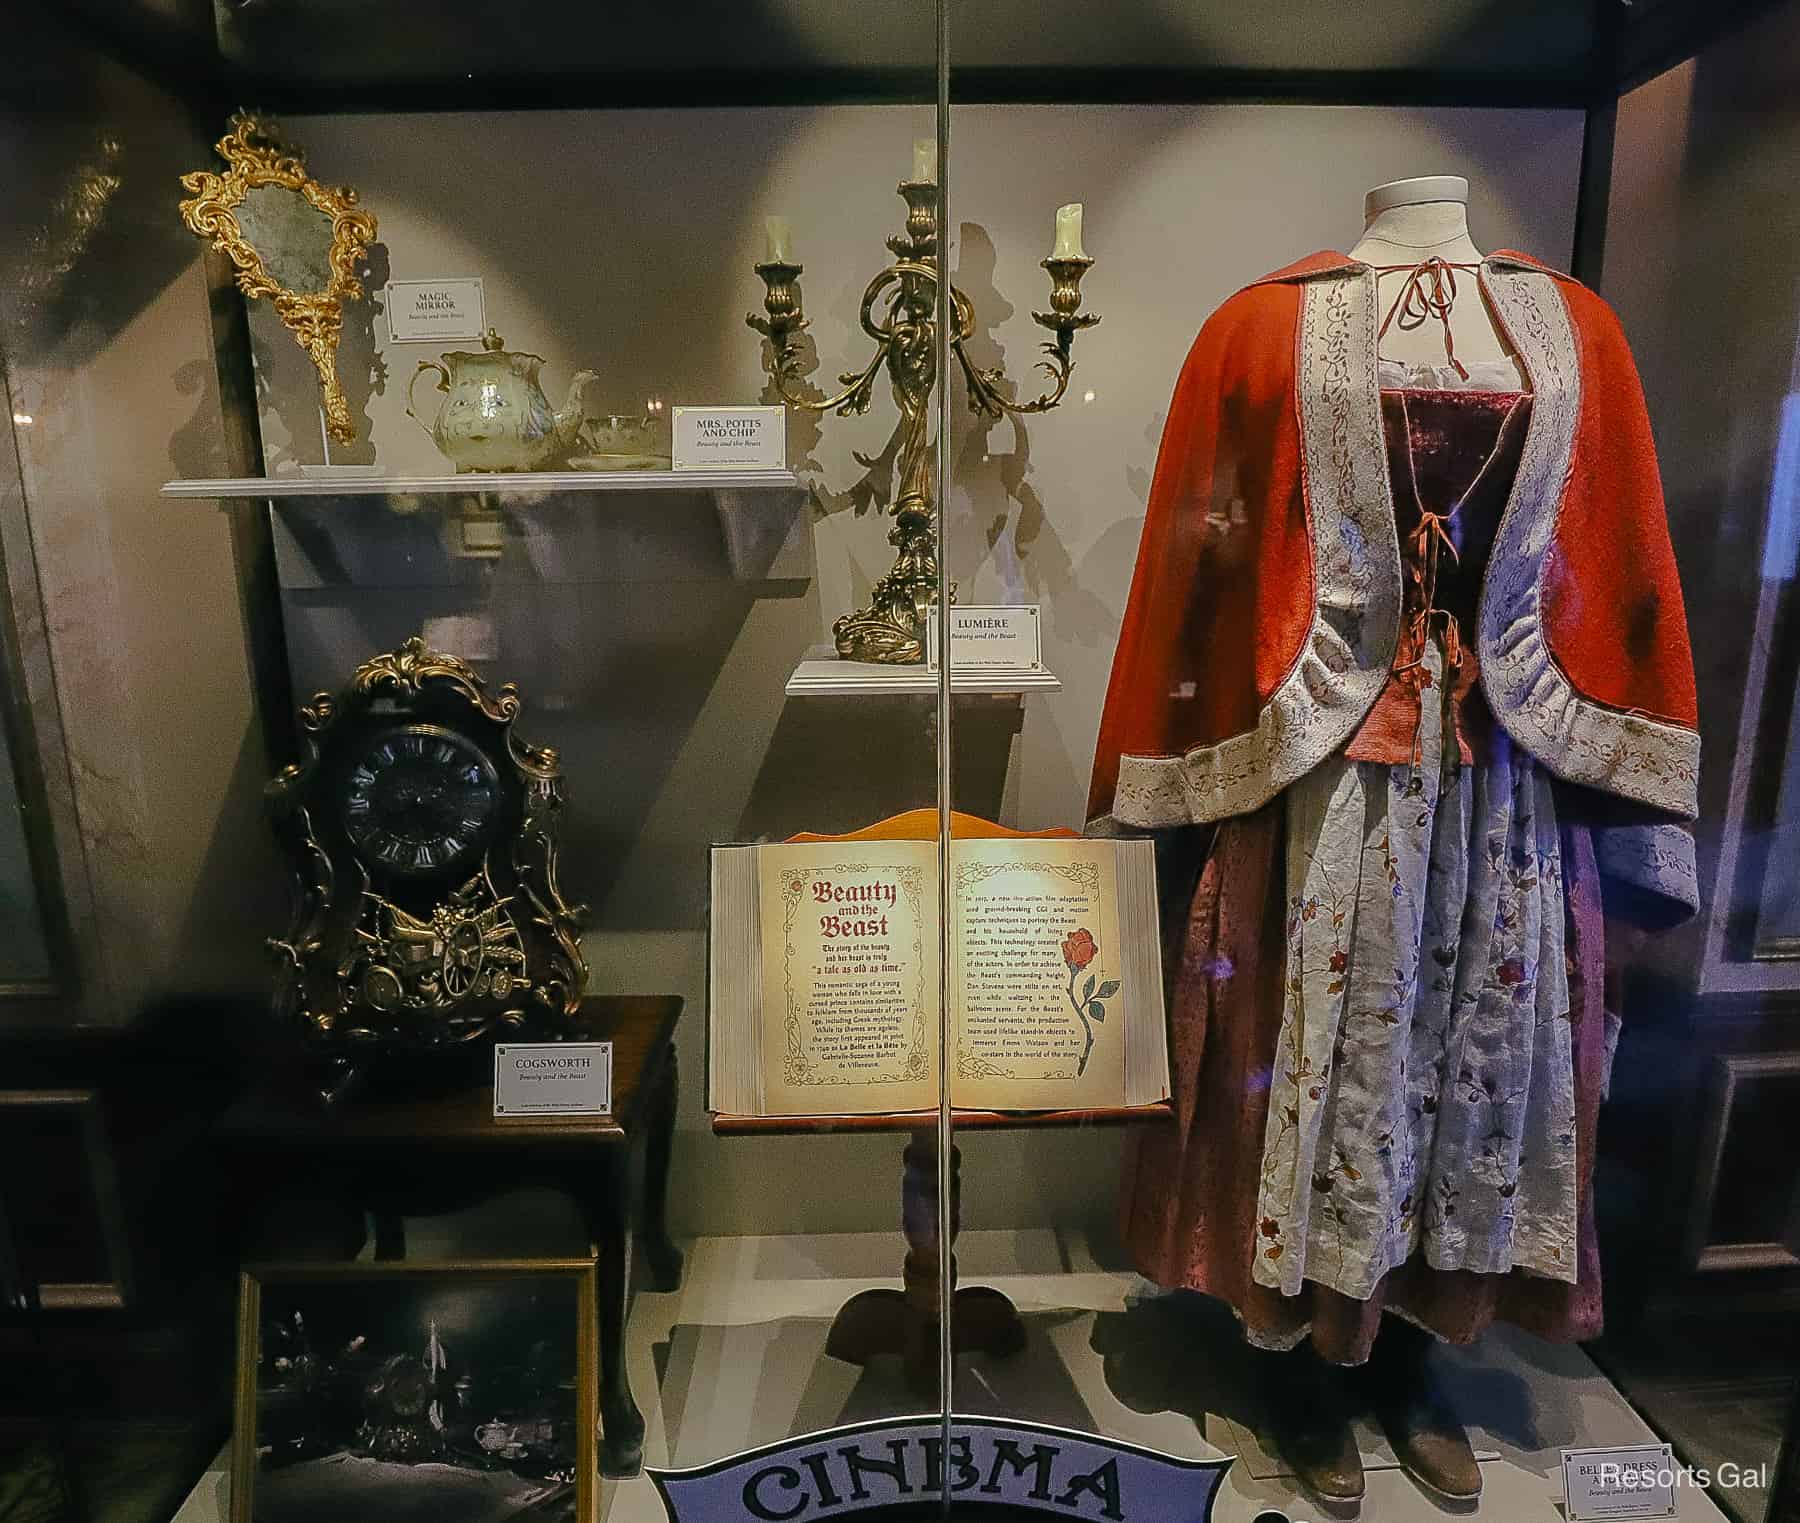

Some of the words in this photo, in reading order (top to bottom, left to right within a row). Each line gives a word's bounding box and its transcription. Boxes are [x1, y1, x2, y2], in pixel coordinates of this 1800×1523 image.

[418, 292, 448, 300] MAGIC
[416, 301, 456, 310] MIRROR
[696, 420, 724, 428] MRS.
[726, 418, 761, 428] POTTS
[702, 428, 727, 437] AND
[728, 428, 756, 437] CHIP
[958, 618, 1008, 628] LUMIÈRE
[812, 880, 896, 908] Beauty
[838, 906, 859, 916] and
[861, 904, 878, 917] the
[820, 914, 888, 938] Beast
[824, 966, 840, 974] tale
[854, 964, 866, 973] old
[515, 1058, 590, 1068] COGSWORTH
[1624, 1461, 1658, 1472] DRESS
[742, 1434, 1125, 1521] CINEMA
